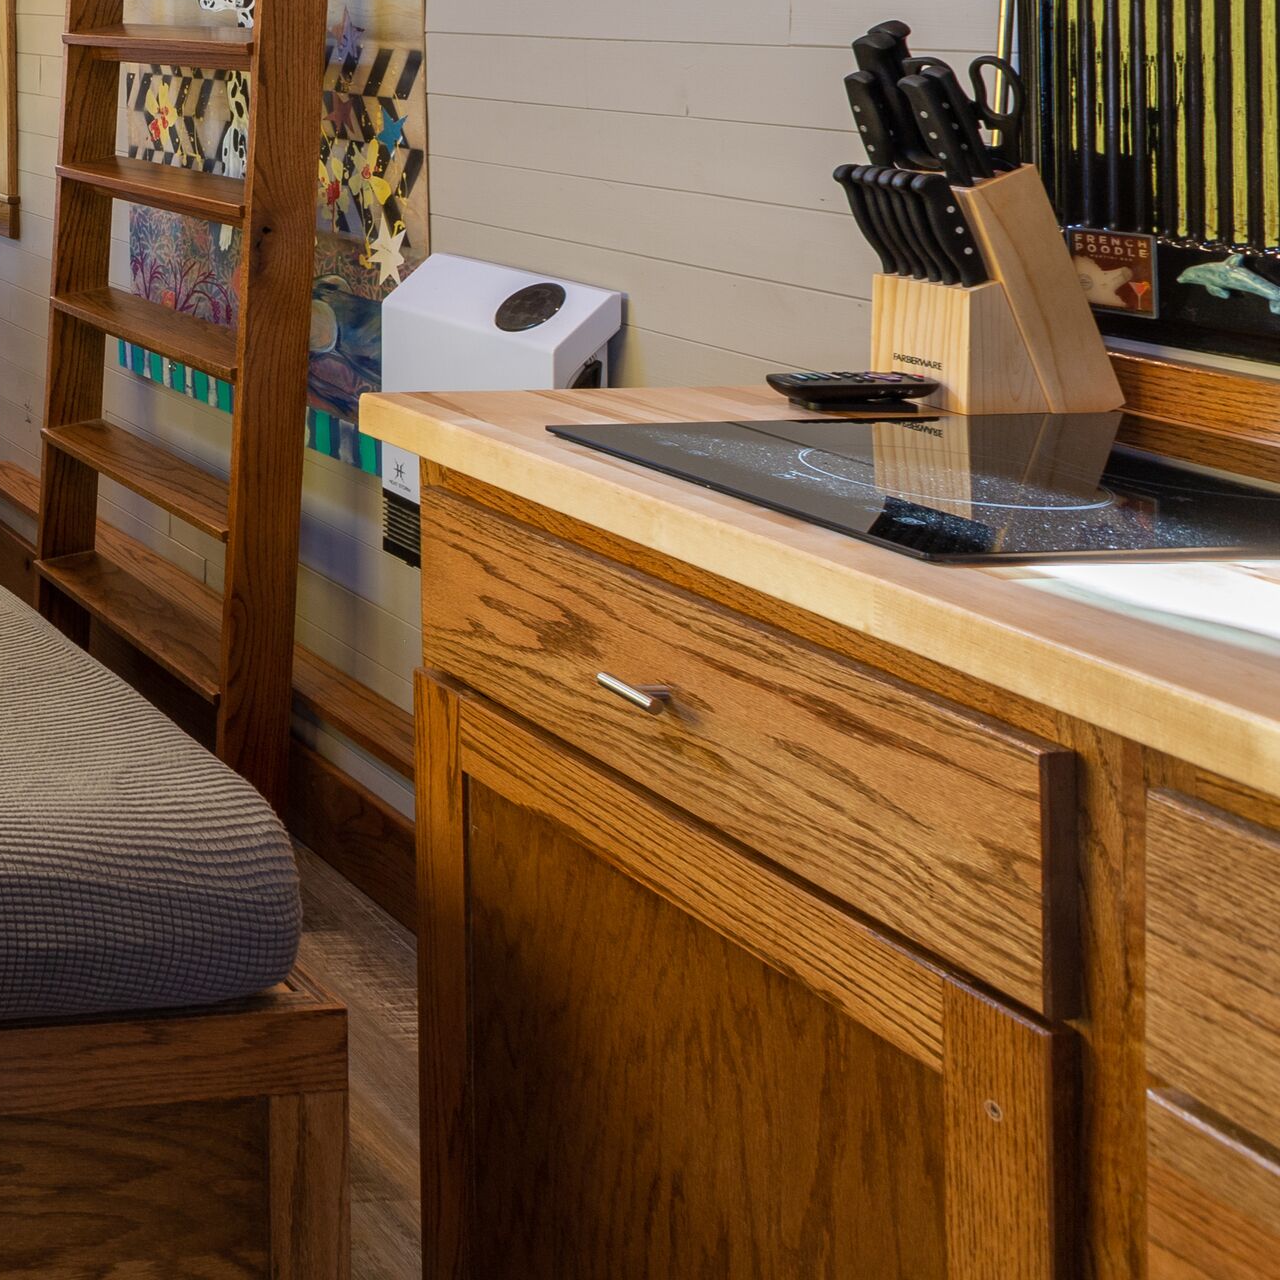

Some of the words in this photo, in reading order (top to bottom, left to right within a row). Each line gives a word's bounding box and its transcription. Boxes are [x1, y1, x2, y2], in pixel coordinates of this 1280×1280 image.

[1074, 233, 1147, 249] FRENCH
[1075, 243, 1149, 258] POODLE
[893, 353, 943, 371] FARBERWARE
